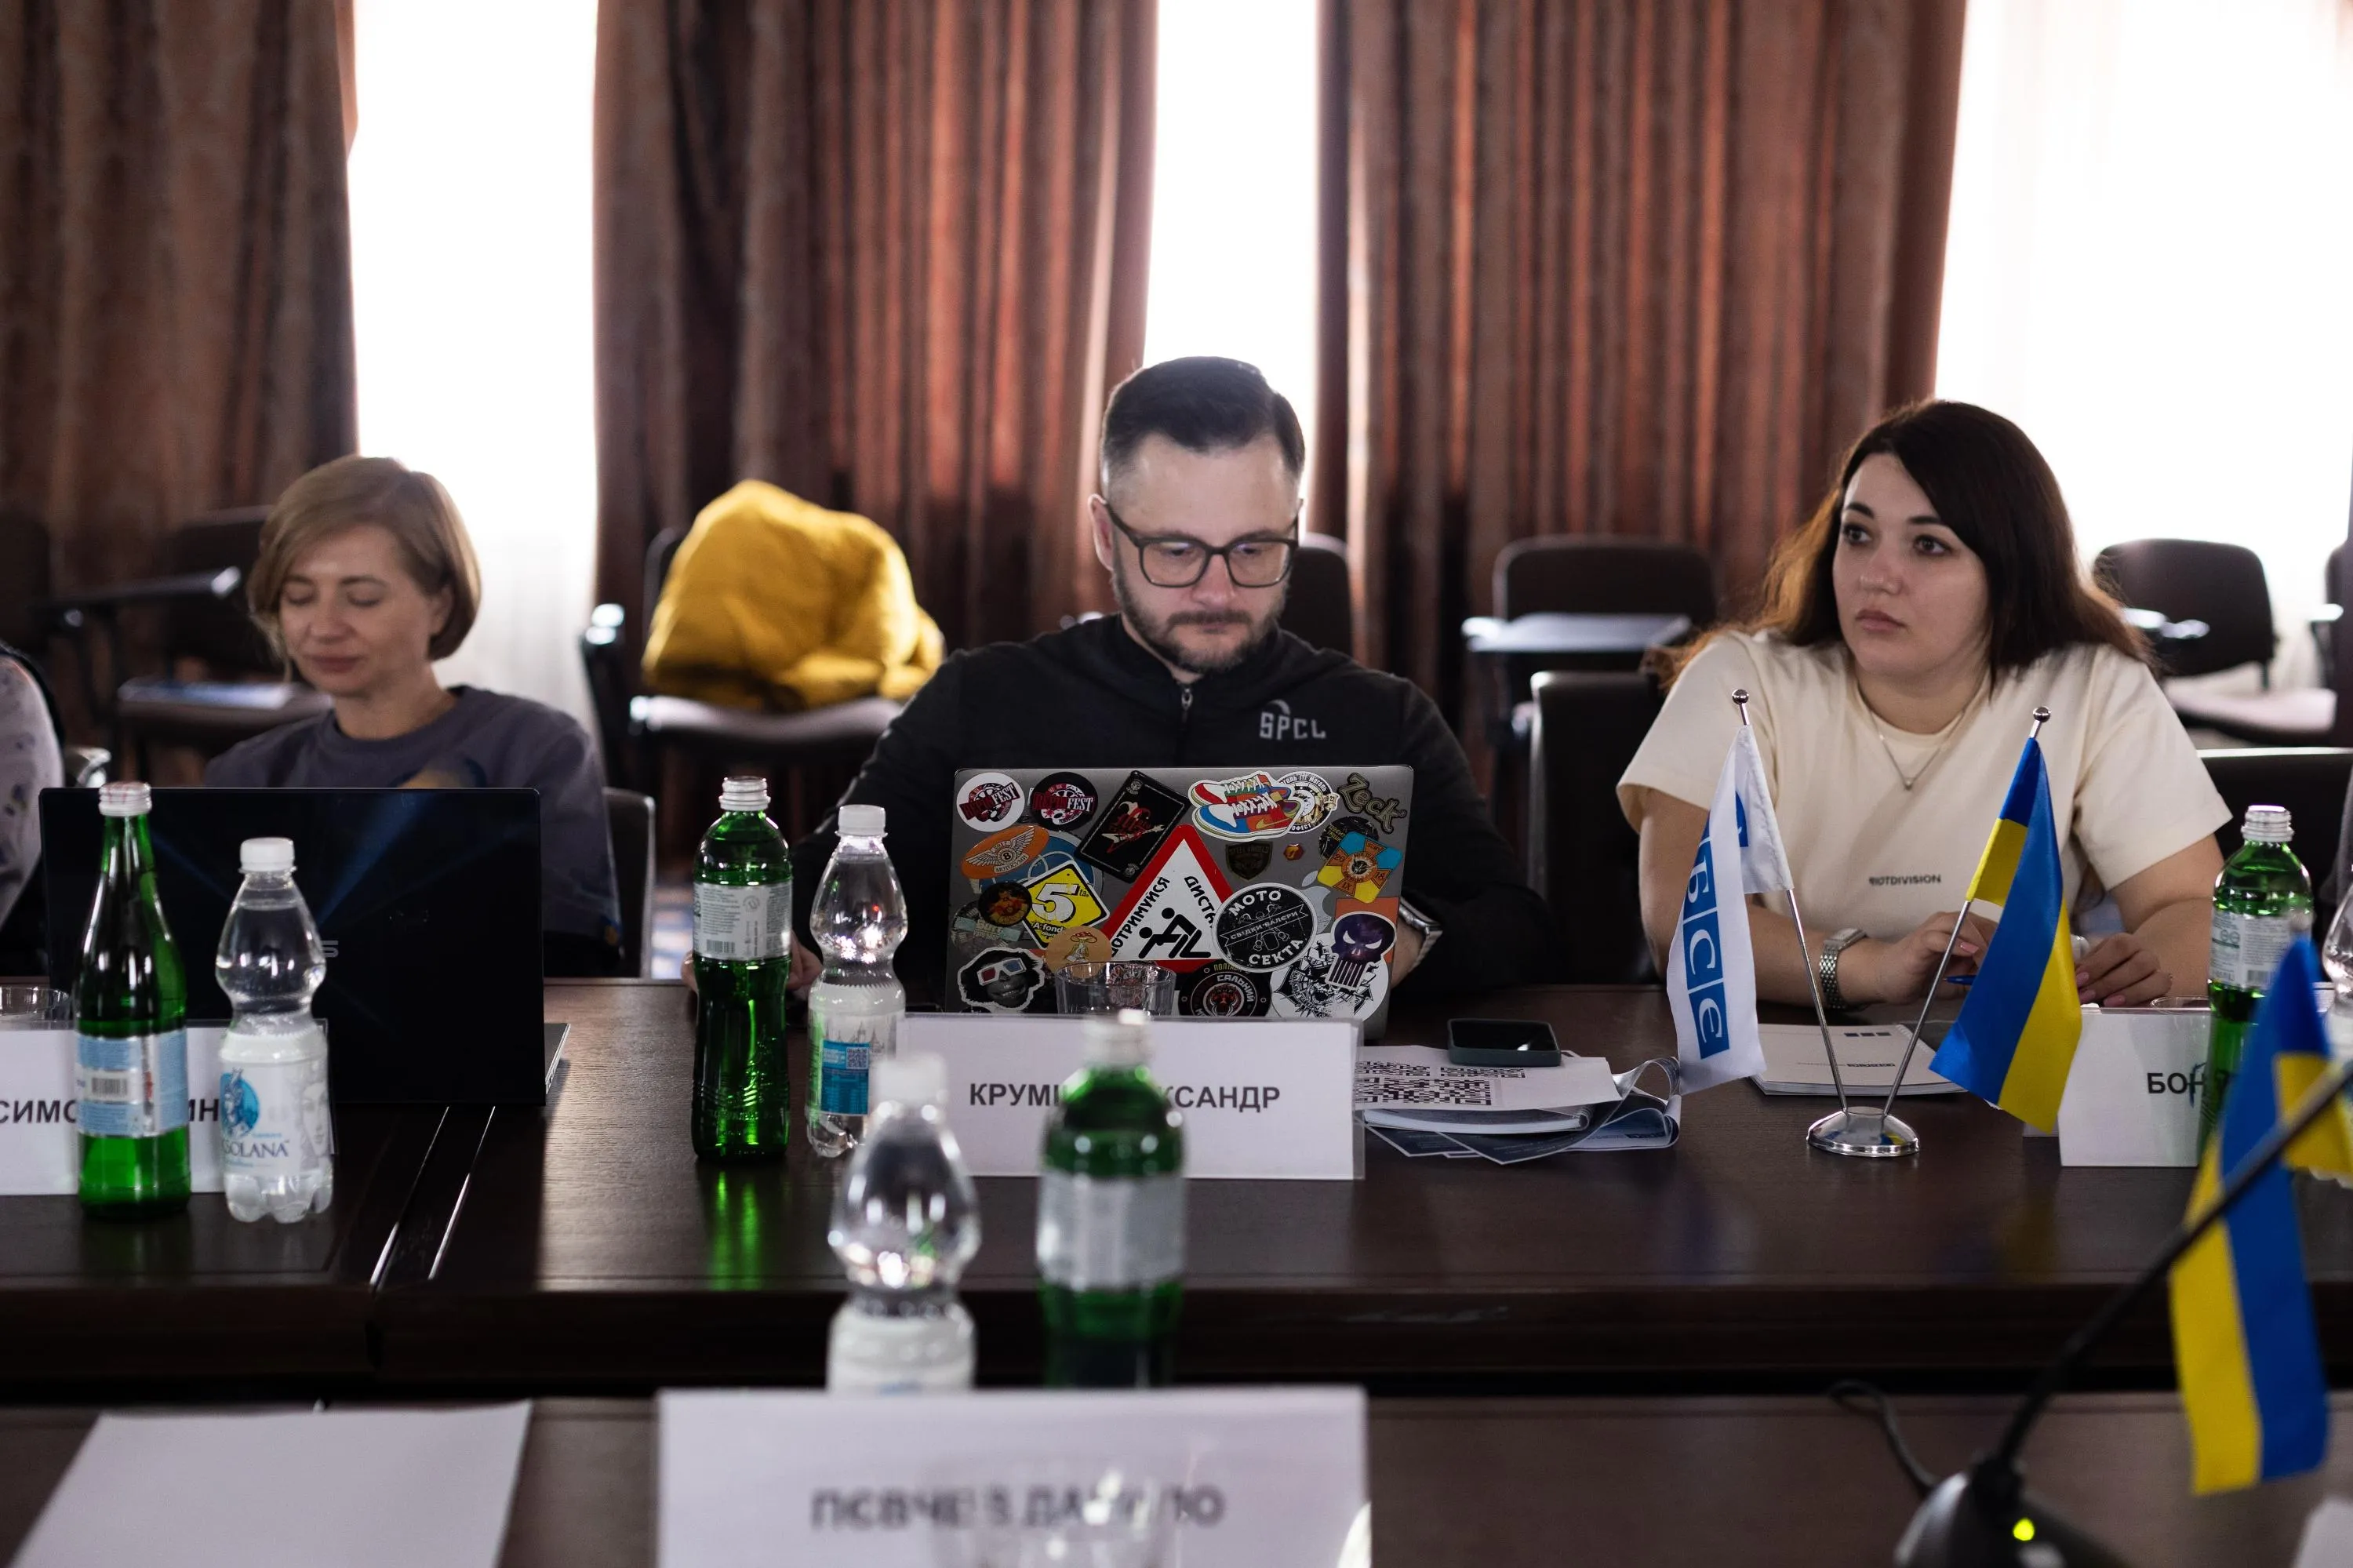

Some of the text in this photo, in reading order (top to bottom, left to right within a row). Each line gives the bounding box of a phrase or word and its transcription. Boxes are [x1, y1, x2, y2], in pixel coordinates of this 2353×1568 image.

[1260, 711, 1326, 740] SPCL
[991, 785, 1016, 805] FEST
[1067, 797, 1093, 812] FEST
[1184, 875, 1217, 928] ДИСТА
[1228, 890, 1282, 916] МОТО
[1249, 940, 1303, 965] СЕКТА
[2147, 1072, 2205, 1094] БОН
[970, 1084, 1059, 1106] КРУМ
